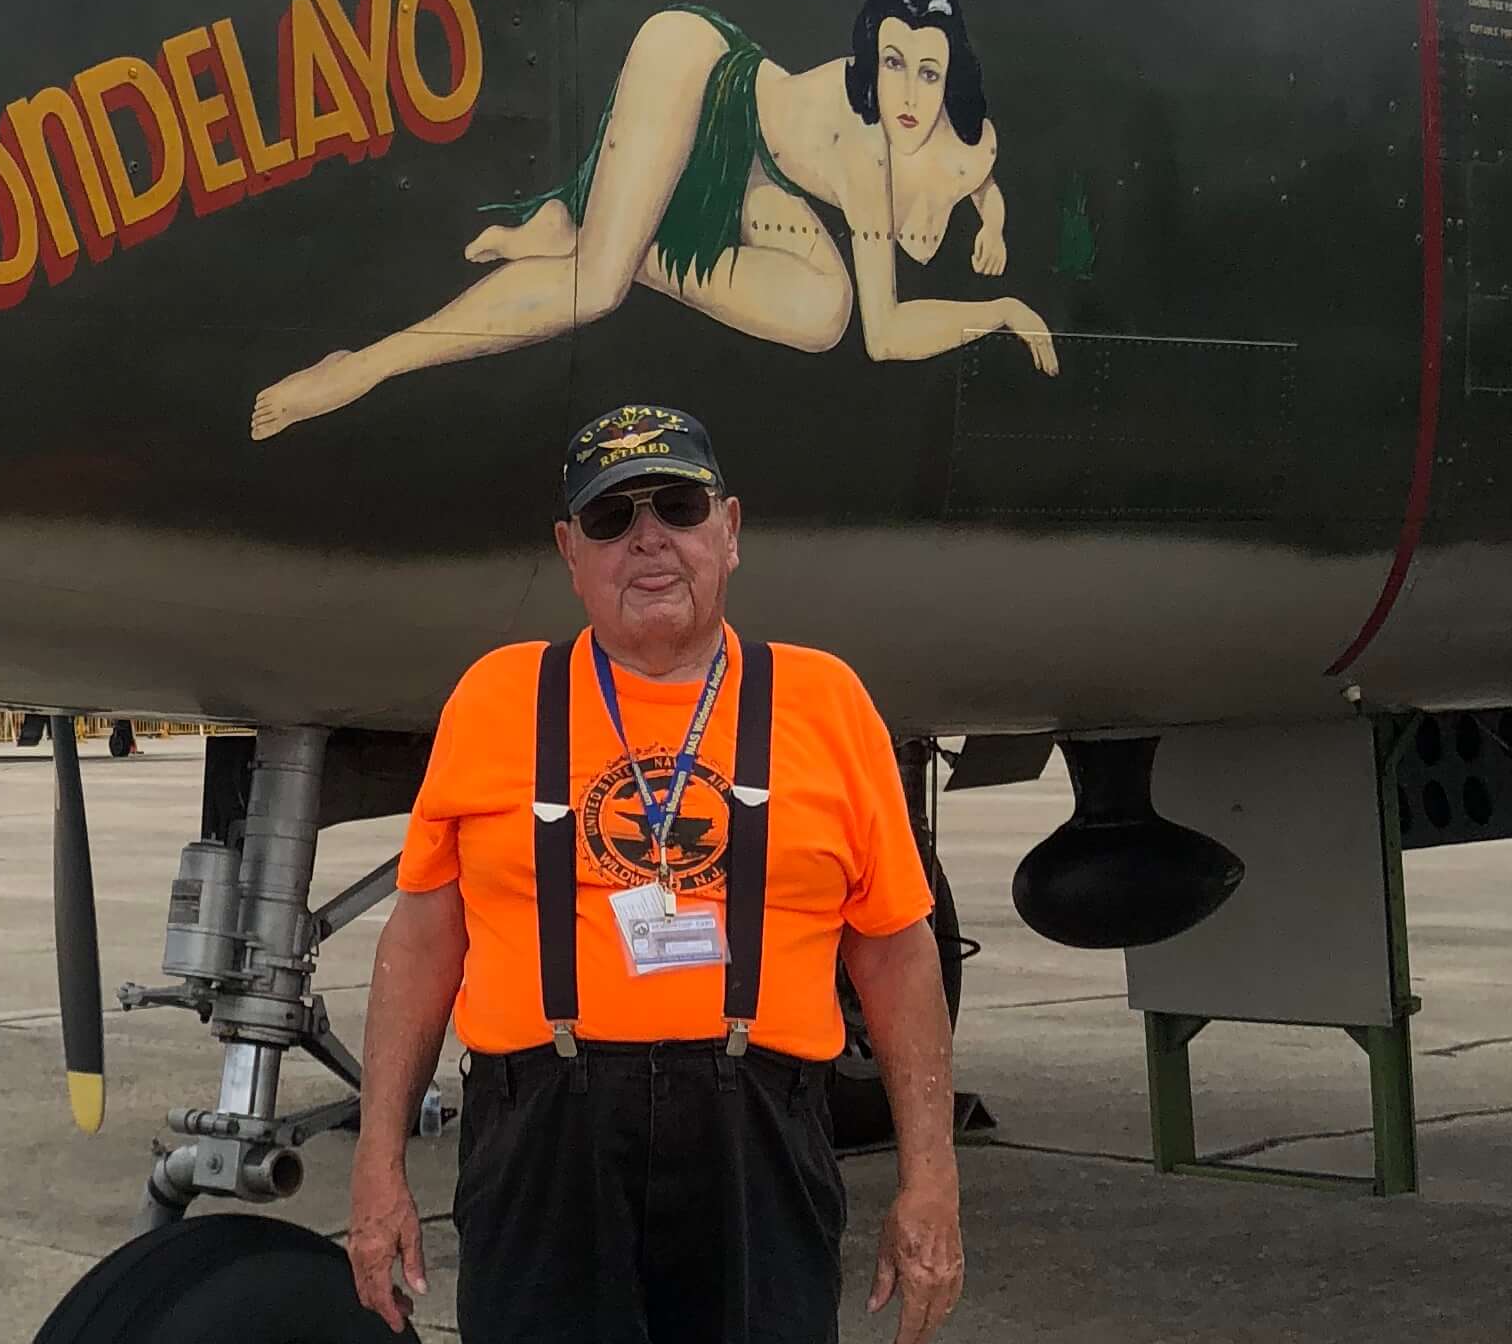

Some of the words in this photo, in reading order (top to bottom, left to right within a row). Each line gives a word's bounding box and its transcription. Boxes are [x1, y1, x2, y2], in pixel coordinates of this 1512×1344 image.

[622, 406, 685, 424] NAVY
[599, 442, 670, 467] RETIRED
[584, 793, 602, 836] UNITED
[598, 766, 633, 791] STATE
[706, 773, 729, 793] AIR
